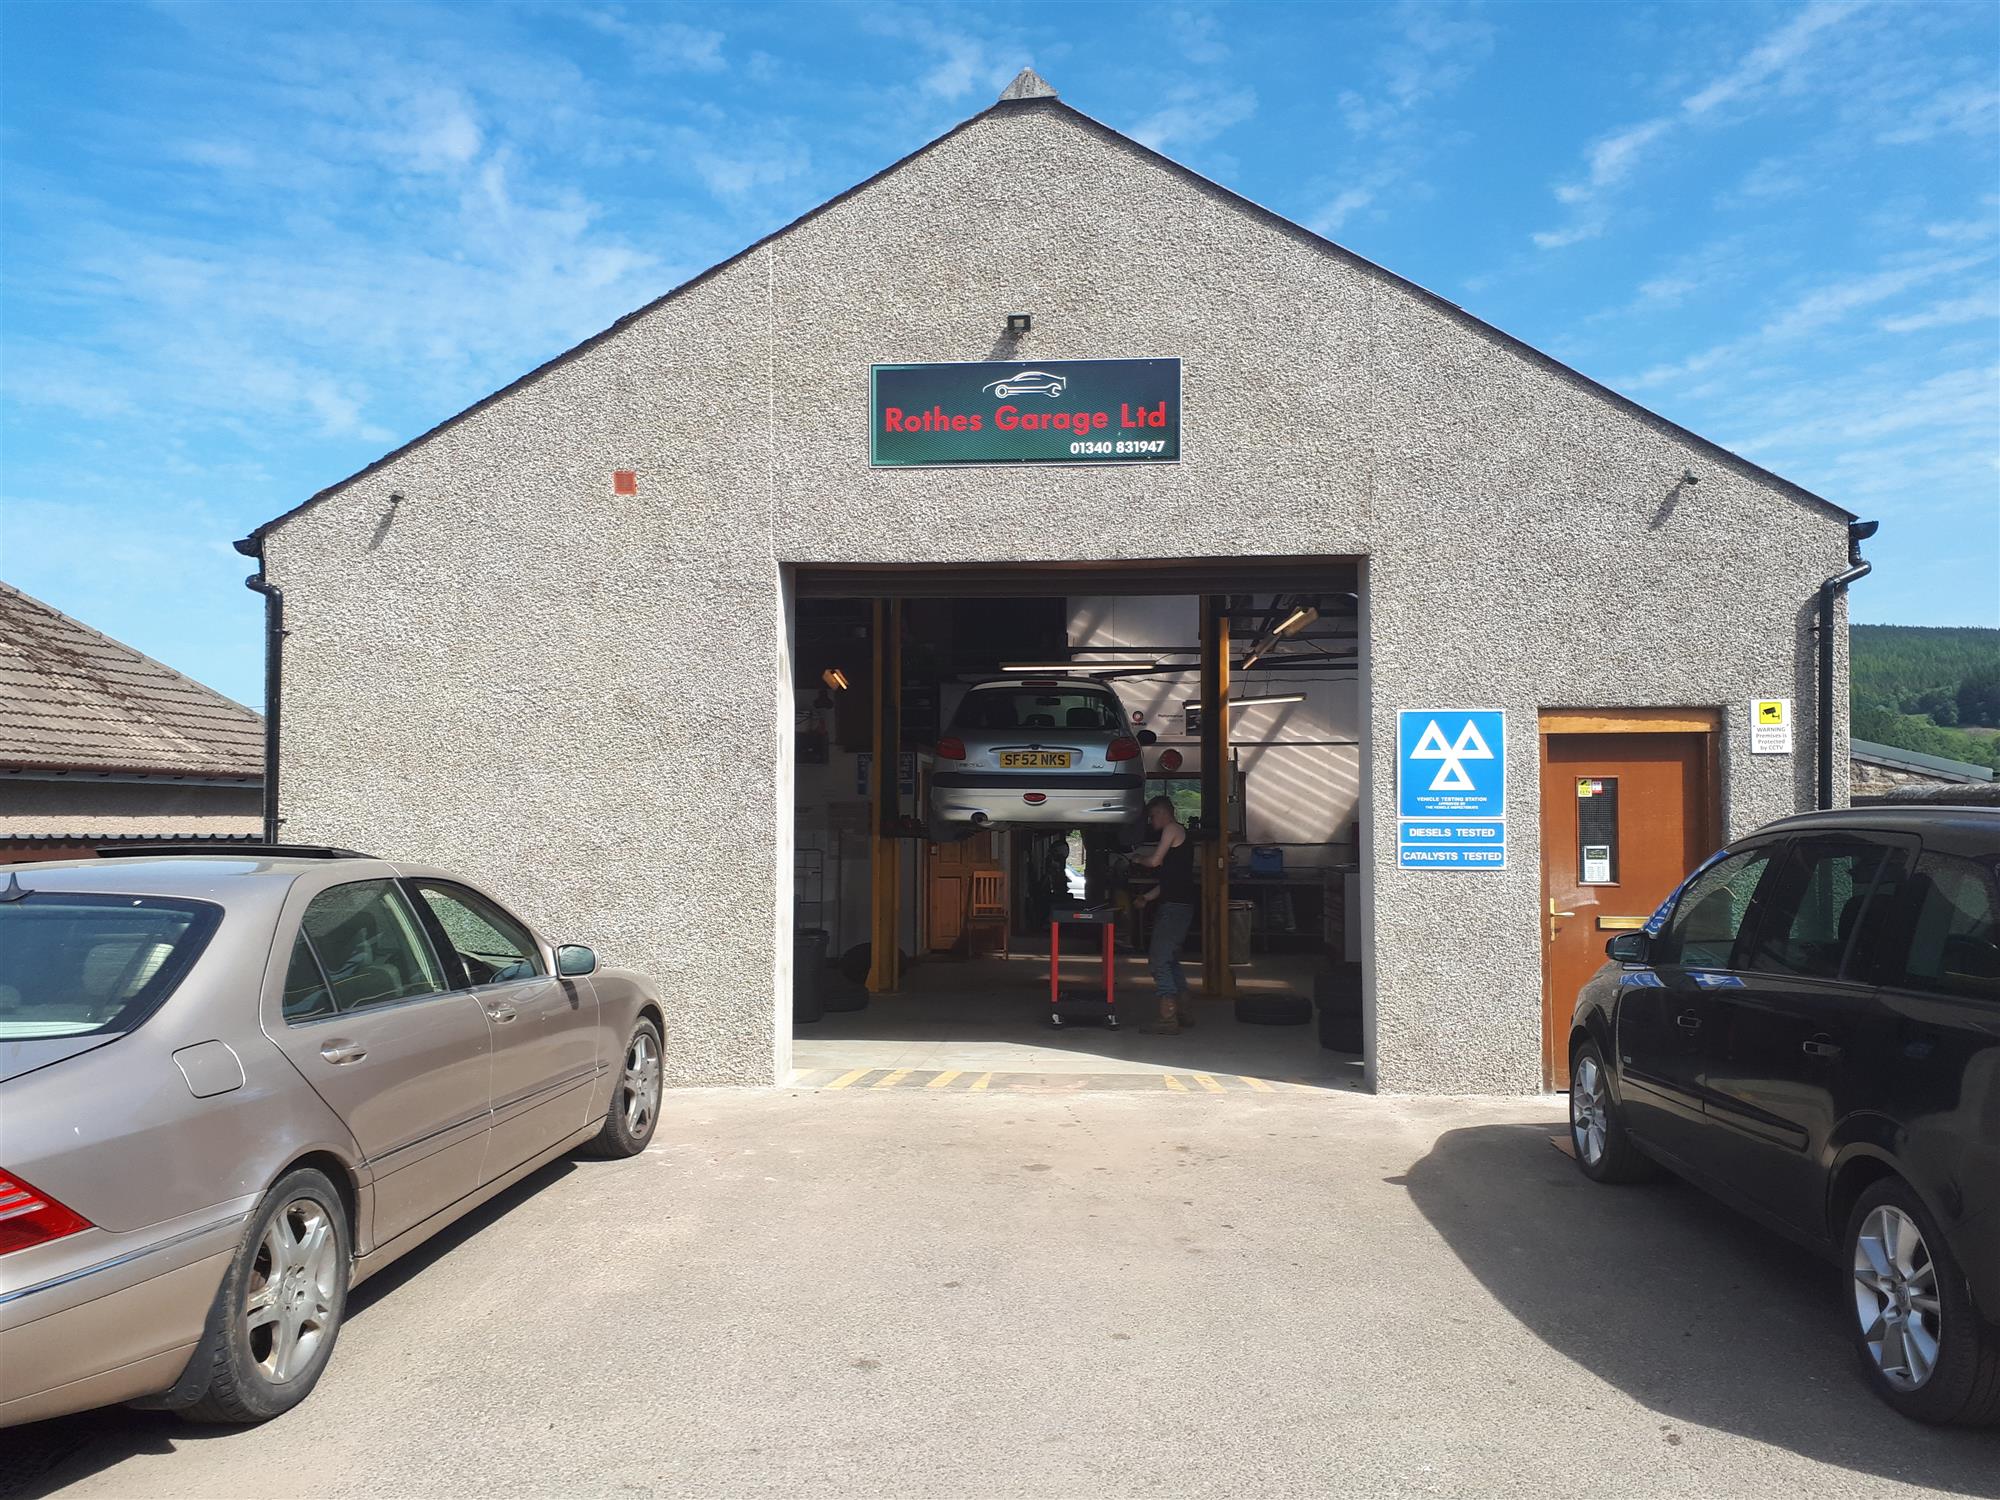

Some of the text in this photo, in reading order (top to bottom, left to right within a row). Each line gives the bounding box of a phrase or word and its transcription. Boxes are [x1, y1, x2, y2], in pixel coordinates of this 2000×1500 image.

[884, 400, 1167, 436] Rothes Garage Ltd
[1070, 440, 1165, 455] 01340 831947
[1004, 754, 1066, 766] SF52 NKS
[1409, 828, 1496, 837] DIESELS TESTED
[1402, 852, 1502, 861] CATALYSTS TESTED
